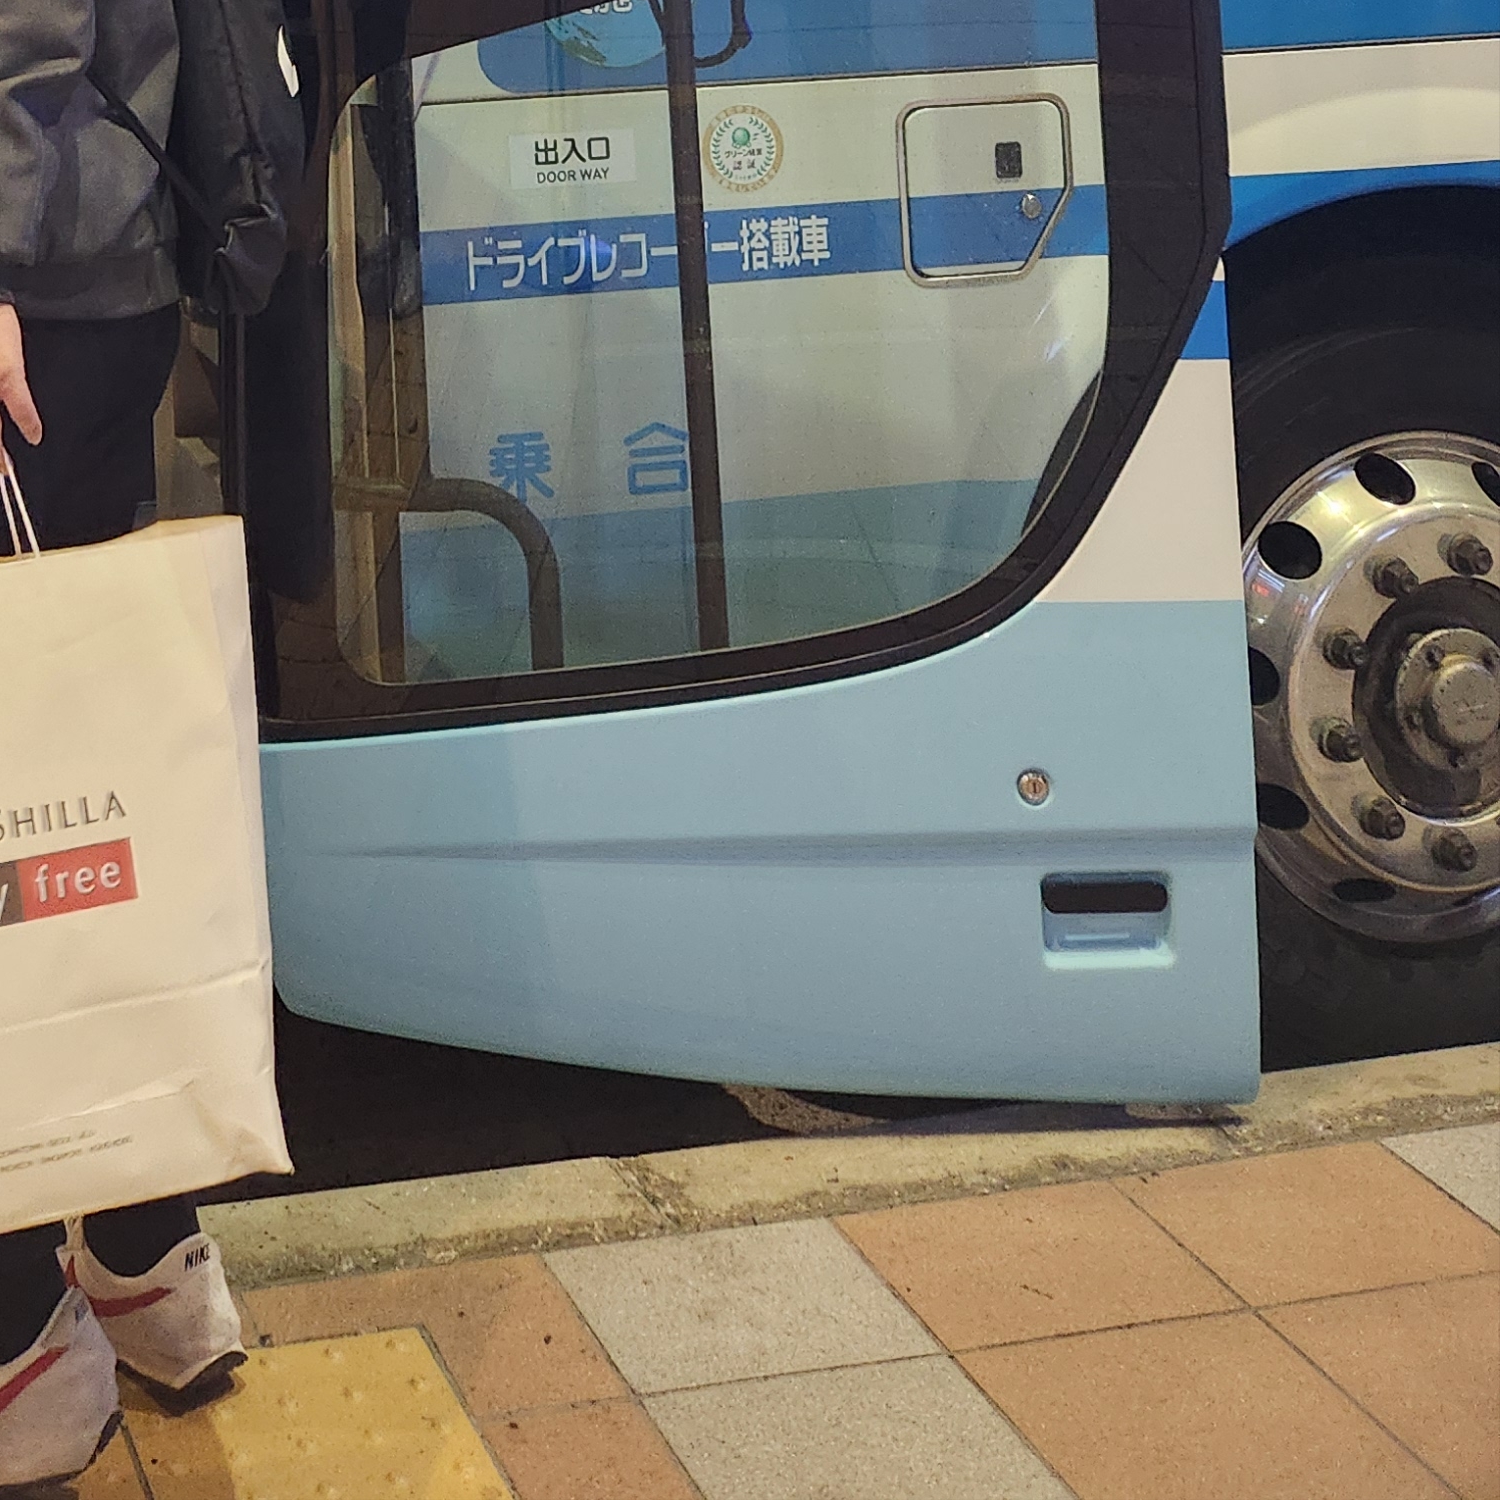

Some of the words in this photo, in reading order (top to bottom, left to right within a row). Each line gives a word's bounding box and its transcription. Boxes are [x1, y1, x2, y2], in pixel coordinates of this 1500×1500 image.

[534, 136, 611, 165] 出入口
[537, 168, 576, 184] DOOR
[580, 167, 610, 181] WAY
[467, 215, 831, 291] ドライブレコーー搭載車
[34, 860, 121, 903] free
[185, 1242, 210, 1271] NIKE
